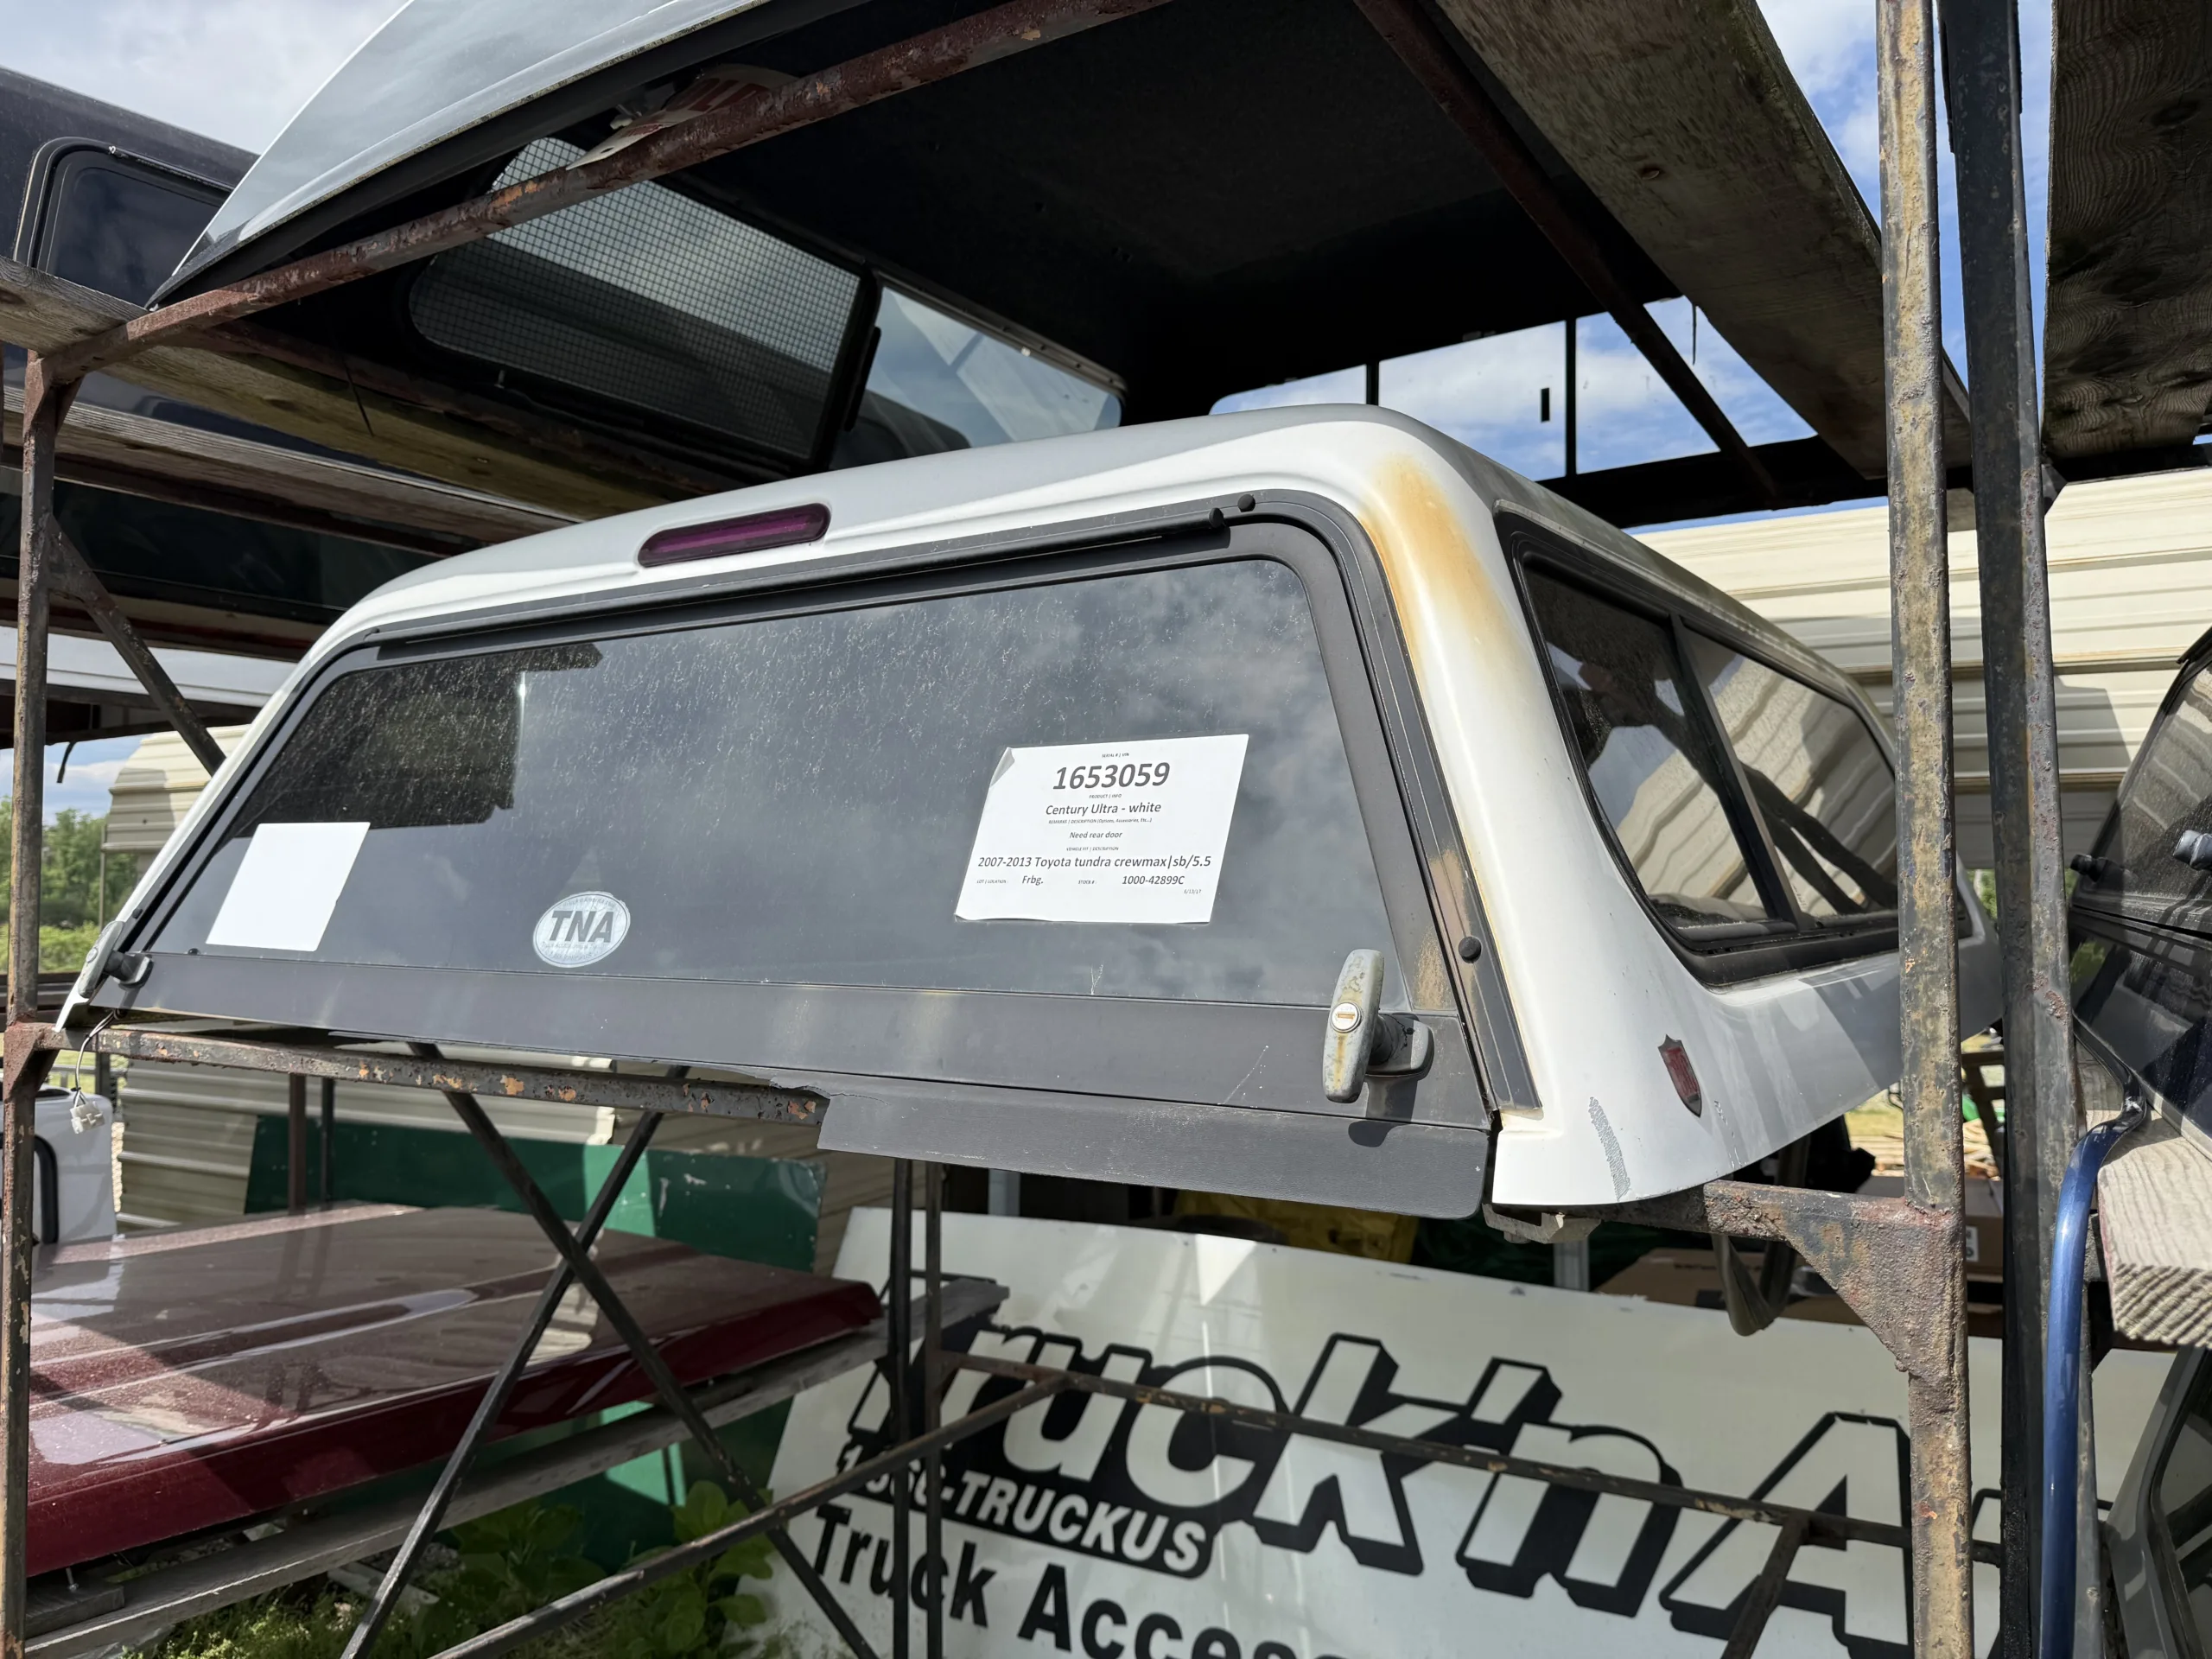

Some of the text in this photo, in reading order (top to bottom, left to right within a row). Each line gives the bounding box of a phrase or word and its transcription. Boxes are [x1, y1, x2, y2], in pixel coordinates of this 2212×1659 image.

[1052, 762, 1171, 790] 1653059
[1046, 804, 1088, 817] Century
[1091, 803, 1118, 814] Ultra
[1128, 802, 1161, 813] white
[978, 855, 1211, 869] 2007-2013 Toyota tundra crewmax|sb/5.5
[1021, 874, 1044, 886] Frbg.
[1122, 875, 1185, 885] 1000-42899C
[549, 910, 614, 943] TNA
[815, 1503, 1350, 1659] Truck Acce
